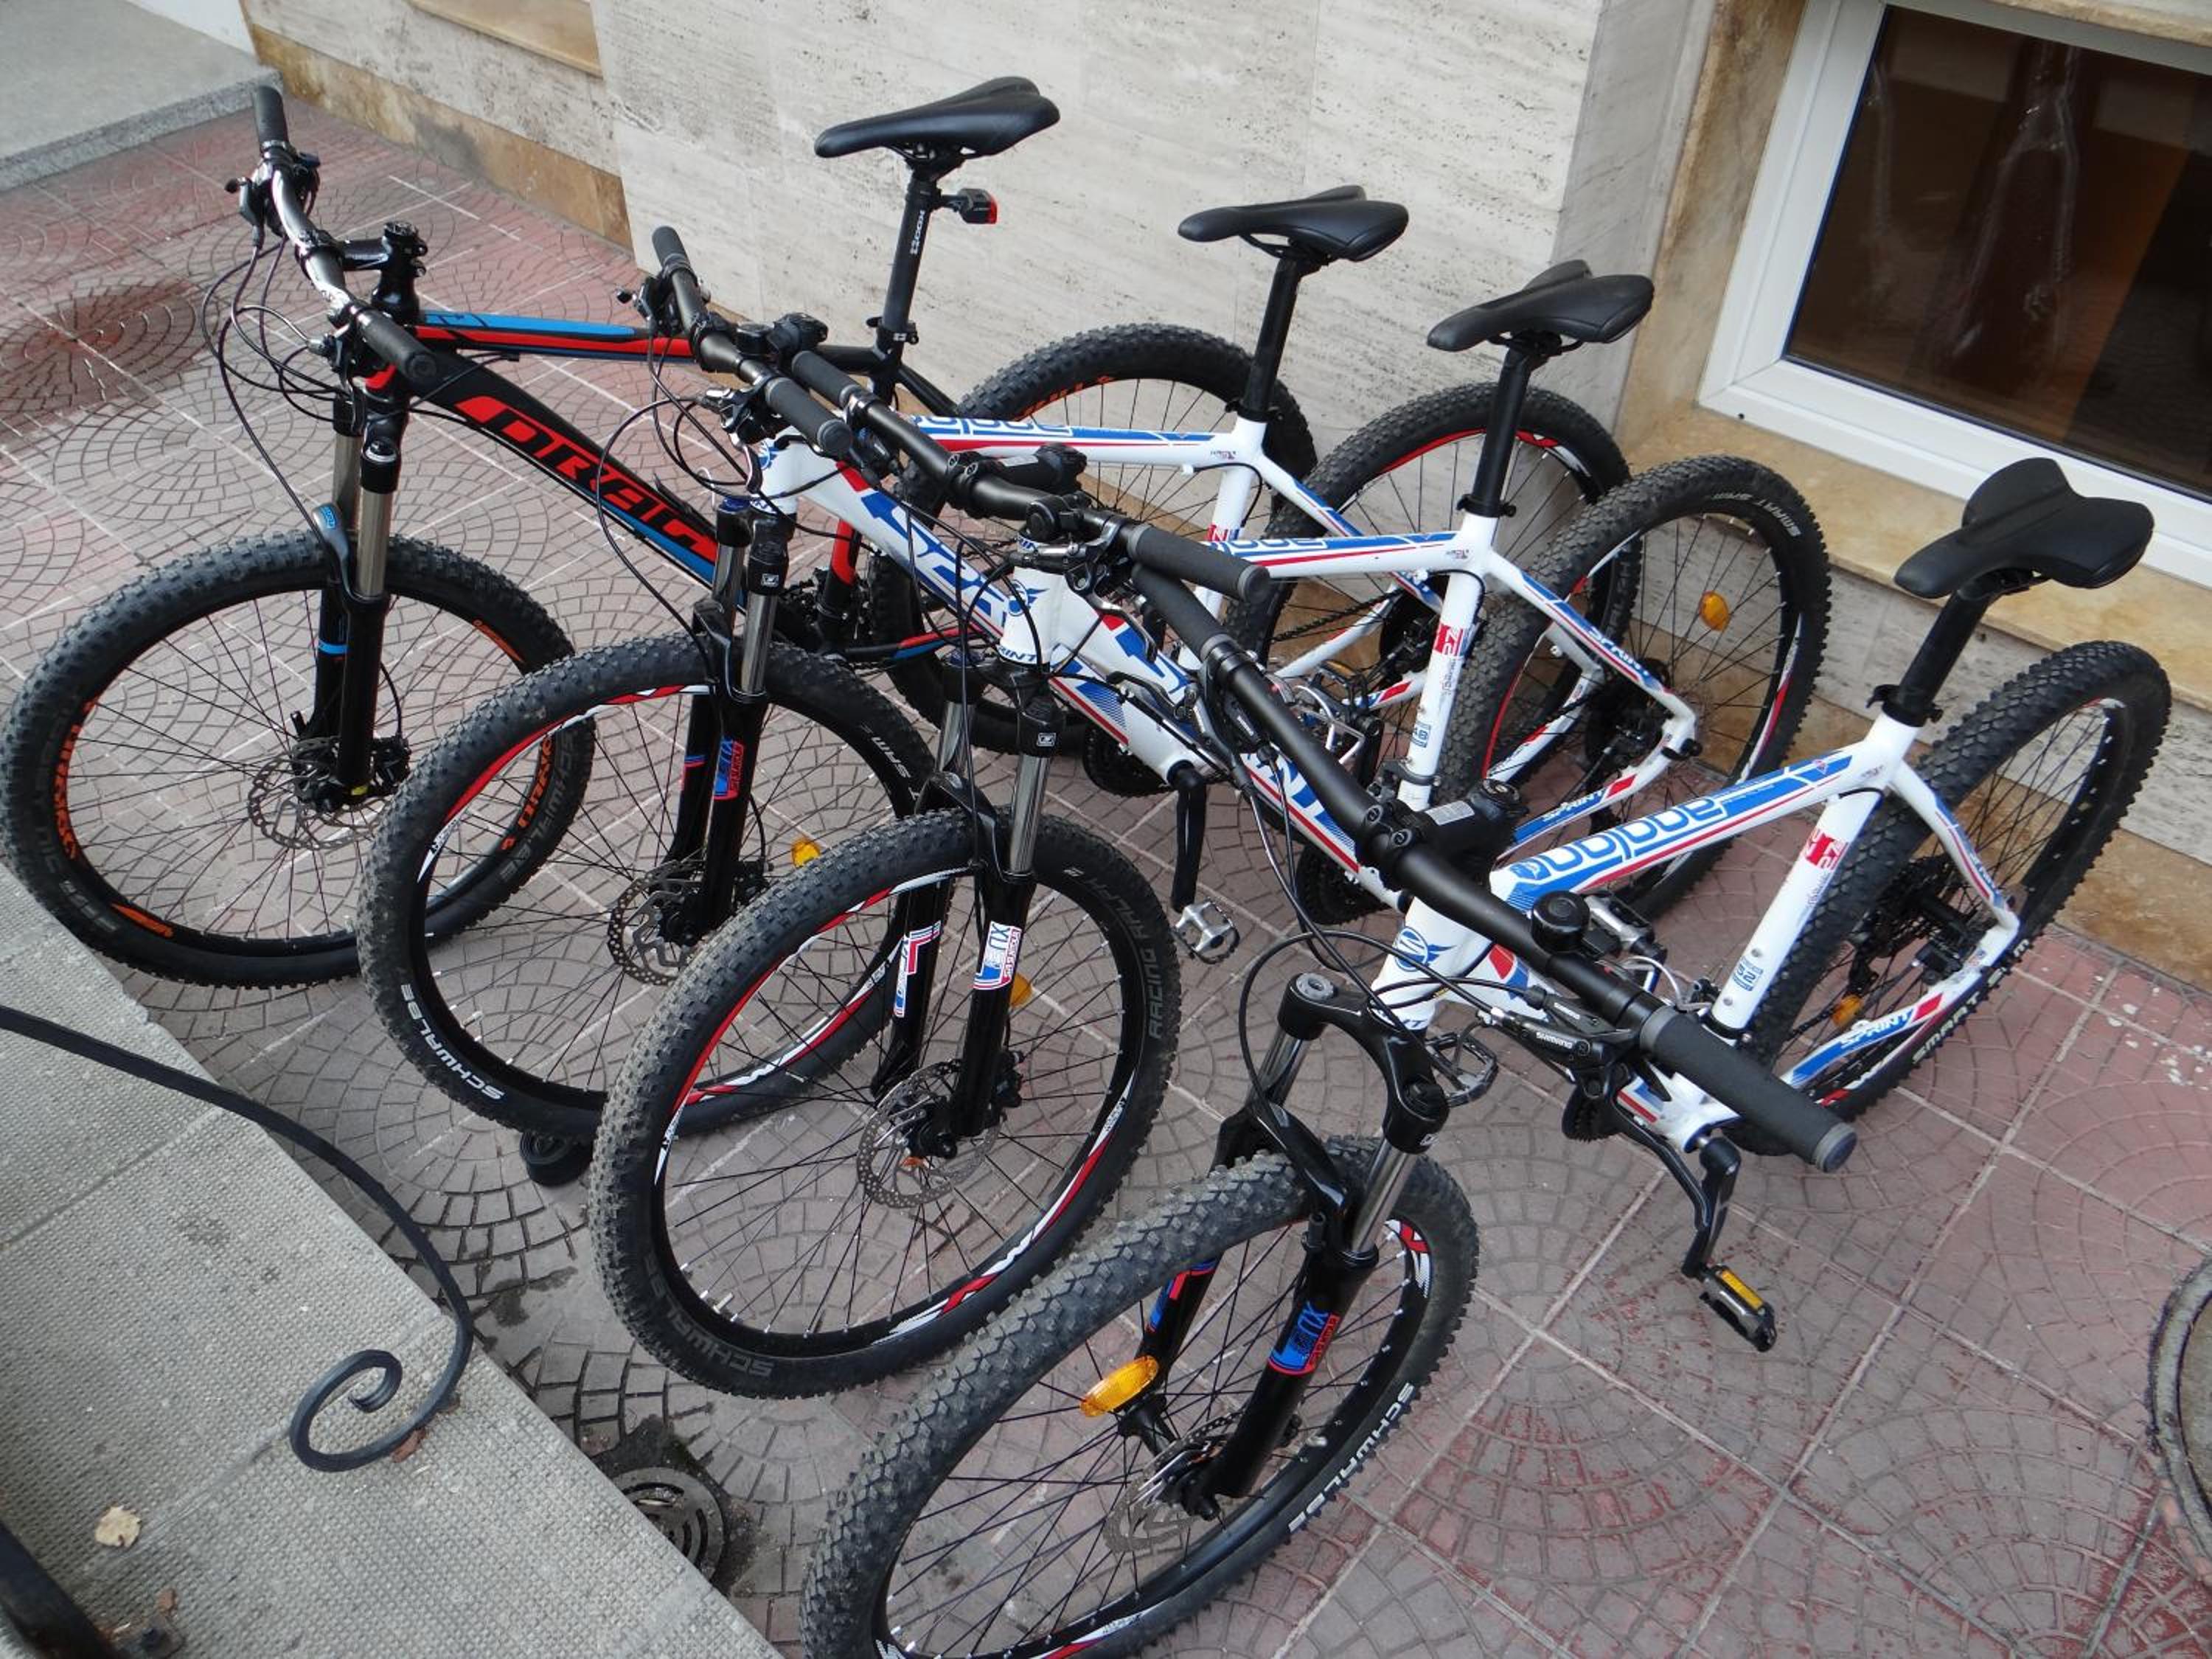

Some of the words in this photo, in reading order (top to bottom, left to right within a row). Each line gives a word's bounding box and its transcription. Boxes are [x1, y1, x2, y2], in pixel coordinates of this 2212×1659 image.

[998, 644, 1037, 664] RINT
[400, 984, 506, 1100] SCHWALBE
[1912, 990, 1980, 1064] SMART
[1288, 1382, 1416, 1534] SCHWALBE
